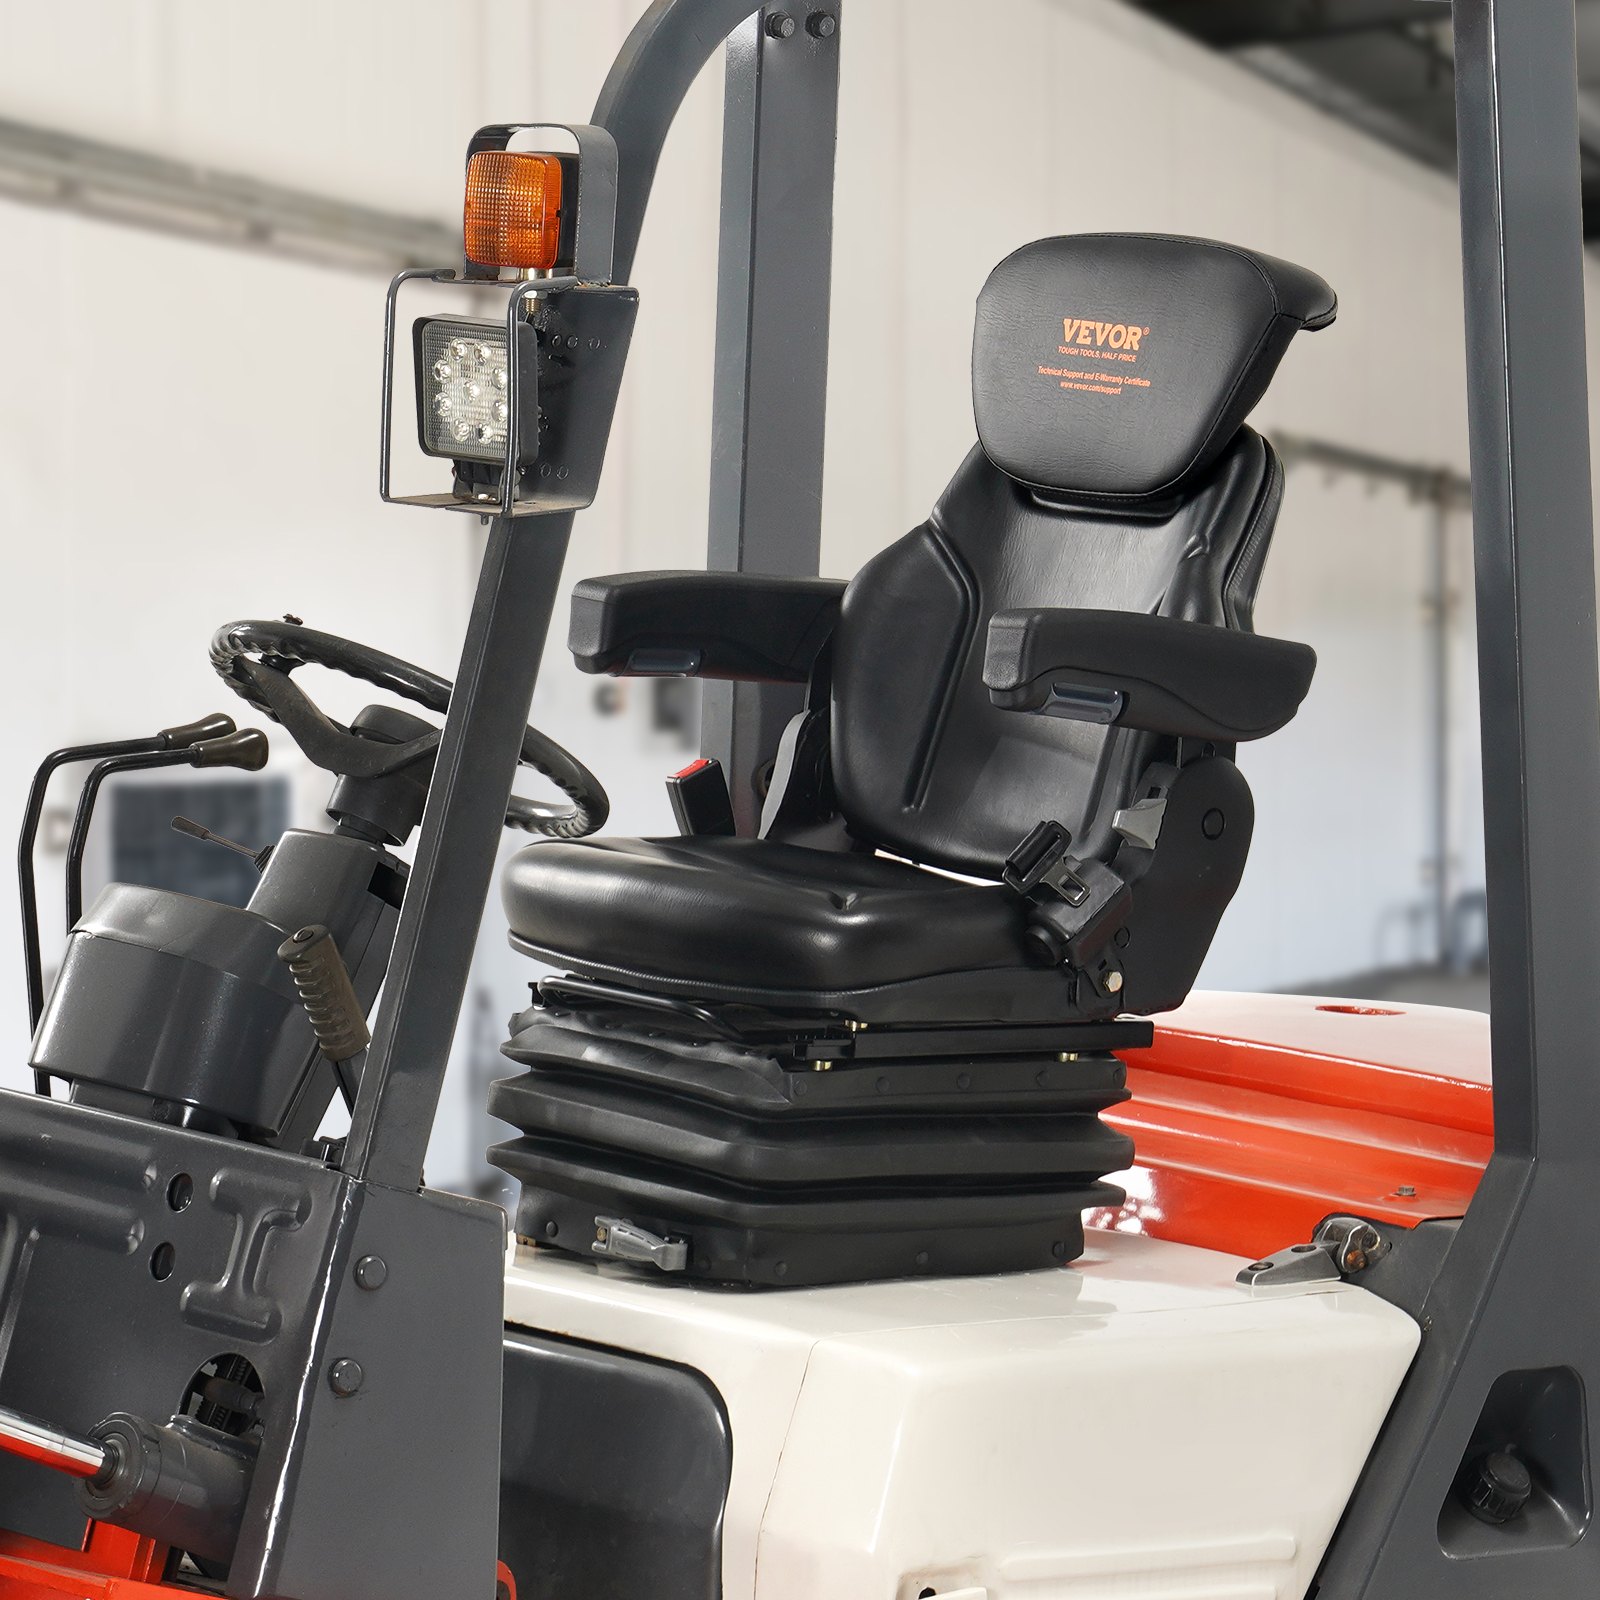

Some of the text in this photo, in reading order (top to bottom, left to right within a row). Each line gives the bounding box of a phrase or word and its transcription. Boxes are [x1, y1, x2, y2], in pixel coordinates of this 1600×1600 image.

[1058, 345, 1137, 363] TOUGH TOOLS, HALF PRICE
[1038, 366, 1151, 387] Technical Support and E-Warranty Certificate
[1060, 381, 1122, 395] www.vevor.com/support
